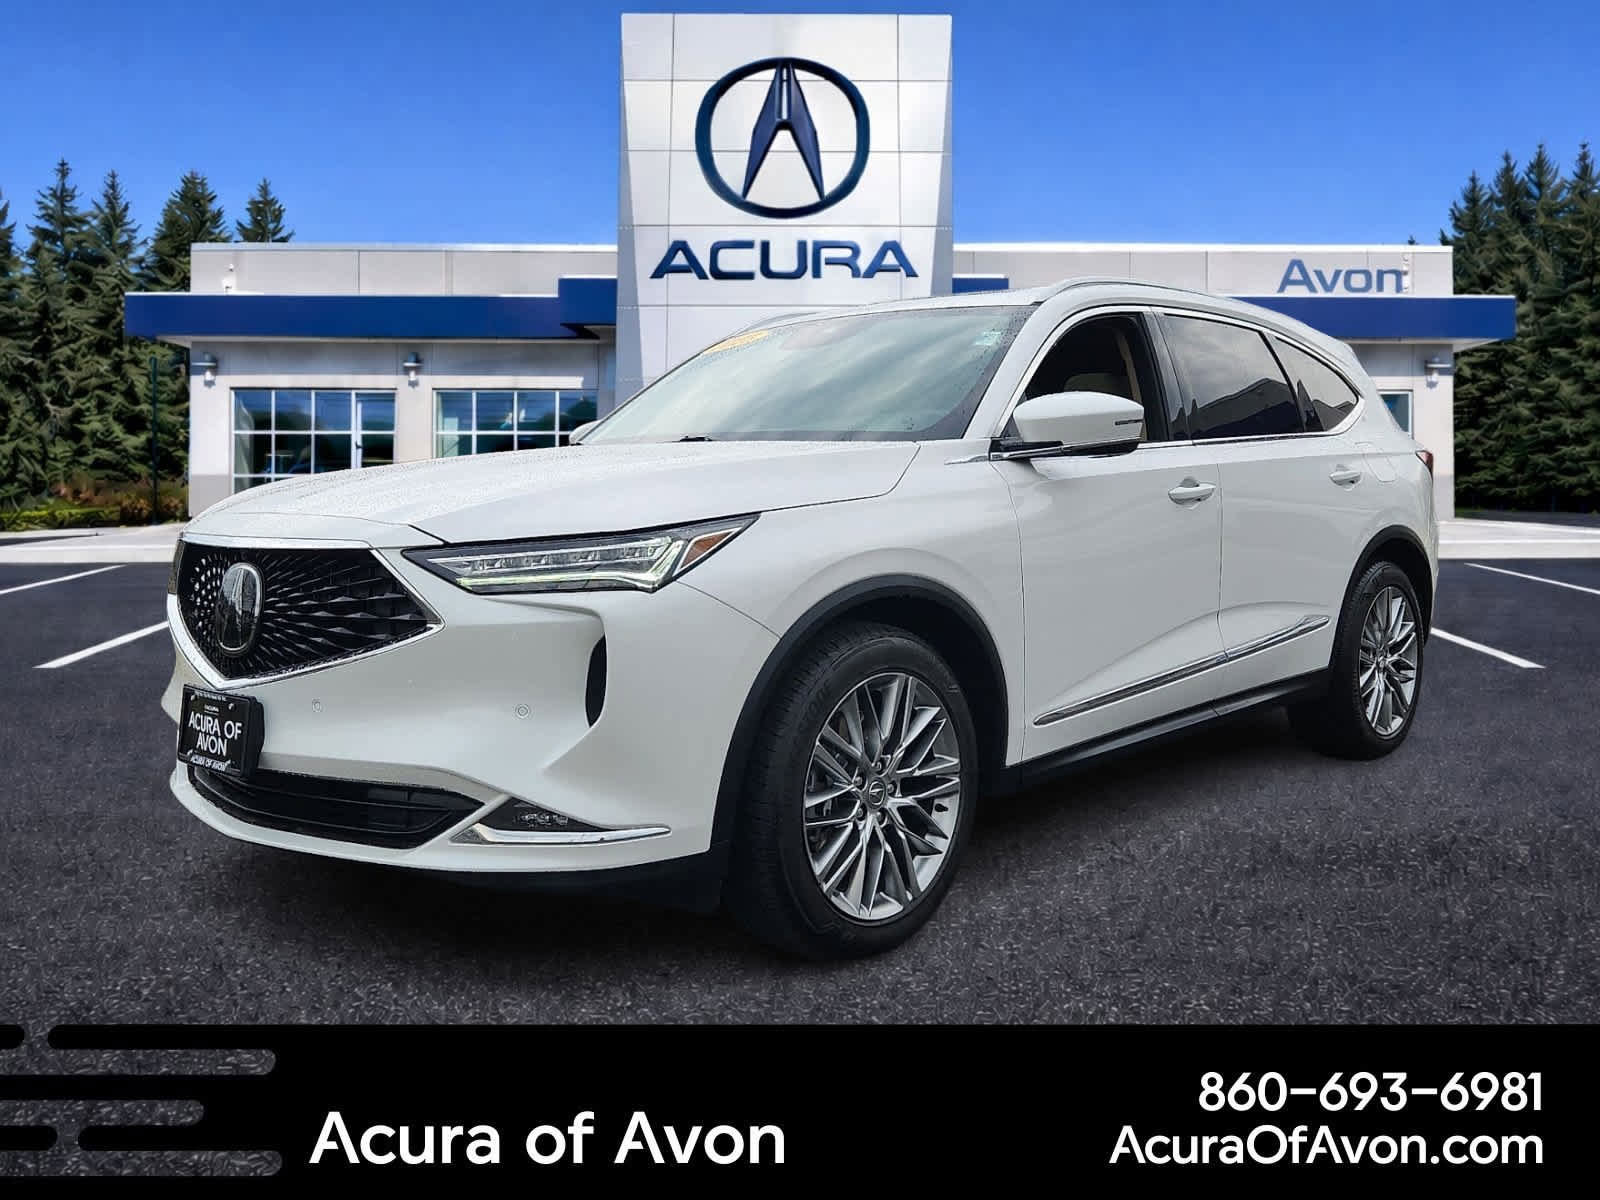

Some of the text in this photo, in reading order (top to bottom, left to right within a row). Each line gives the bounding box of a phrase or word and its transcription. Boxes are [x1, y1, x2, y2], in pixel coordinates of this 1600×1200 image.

[649, 240, 919, 280] ACURA
[1276, 258, 1403, 293] Avon
[188, 711, 242, 740] ACURA OF
[196, 732, 227, 757] AVON
